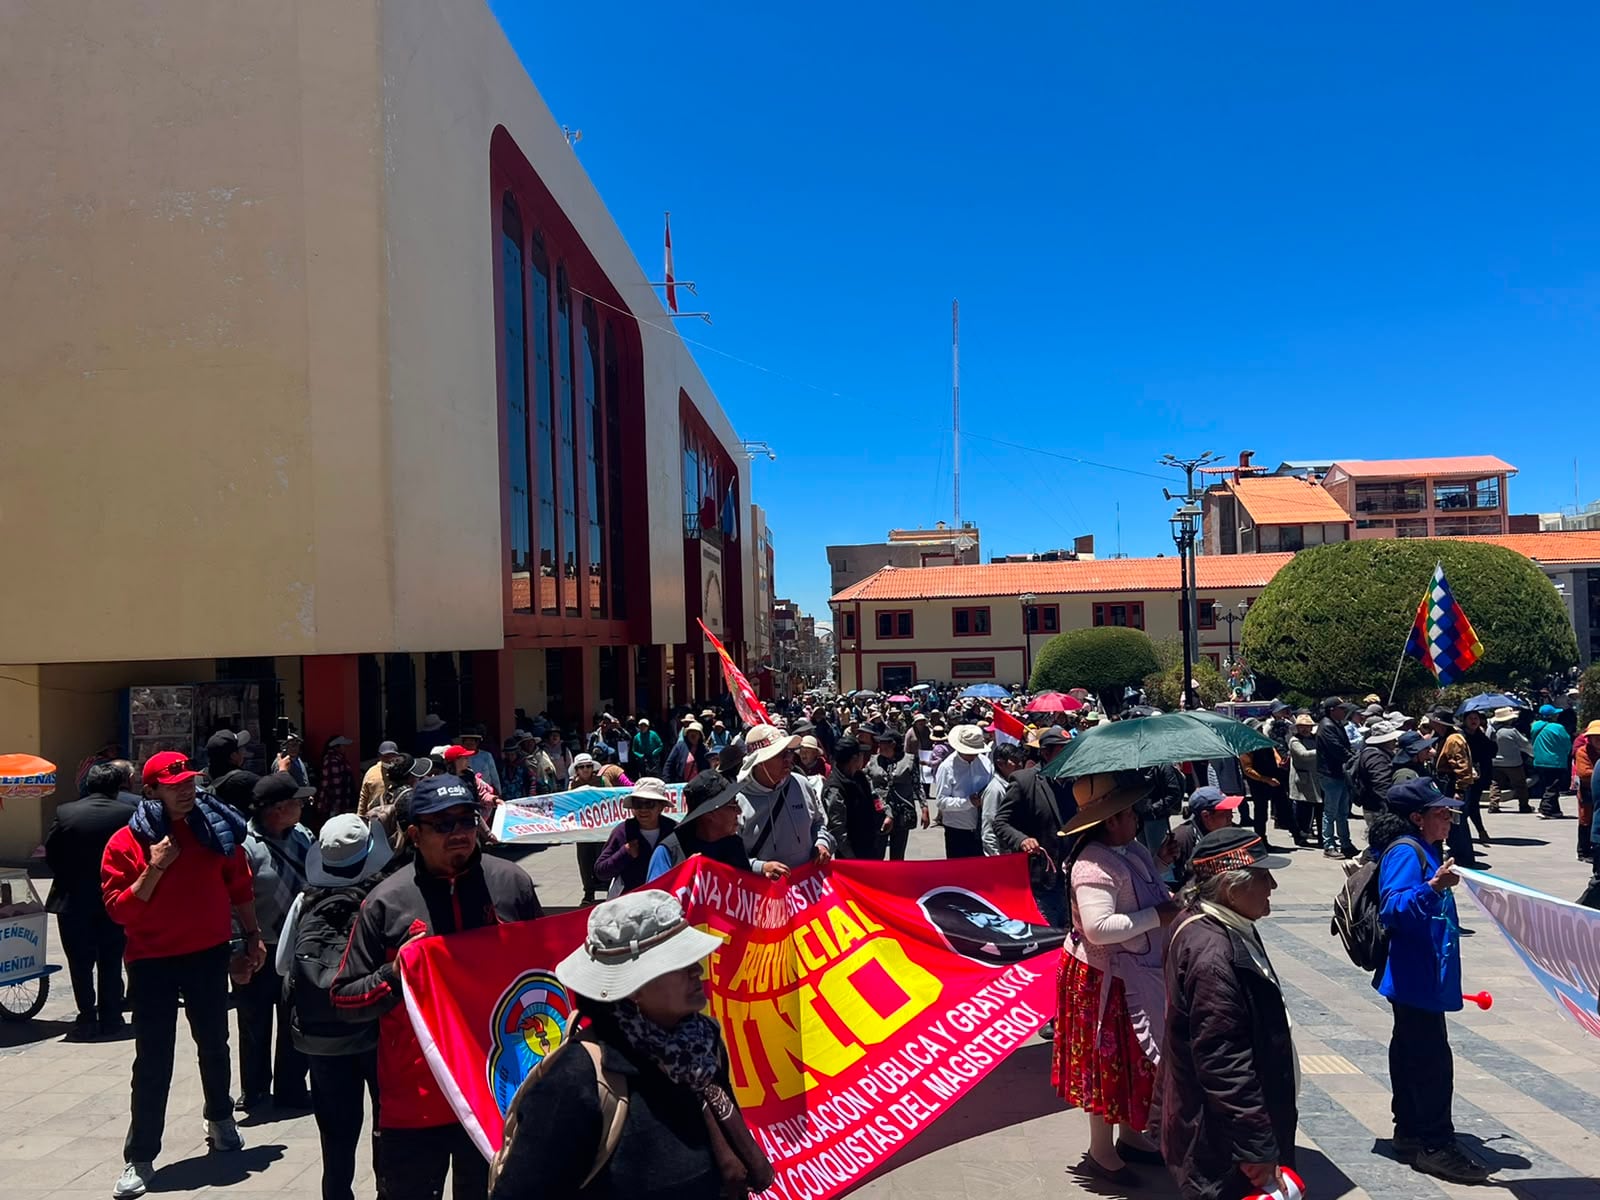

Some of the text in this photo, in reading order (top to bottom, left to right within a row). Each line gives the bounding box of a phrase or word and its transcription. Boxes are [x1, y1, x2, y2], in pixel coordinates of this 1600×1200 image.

[508, 823, 560, 834] CENTRAL
[700, 936, 944, 1109] UNO
[728, 899, 886, 994] PROVINCIAL
[767, 1086, 874, 1159] EDUCACIÓN
[857, 1034, 948, 1103] PÚBLICA
[928, 1020, 958, 1045] Y
[945, 963, 1042, 1033] GRATUITA
[786, 1115, 905, 1200] CONQUISTAS
[888, 1090, 941, 1131] DEL
[922, 1000, 1046, 1100] MAGISTERIO!
